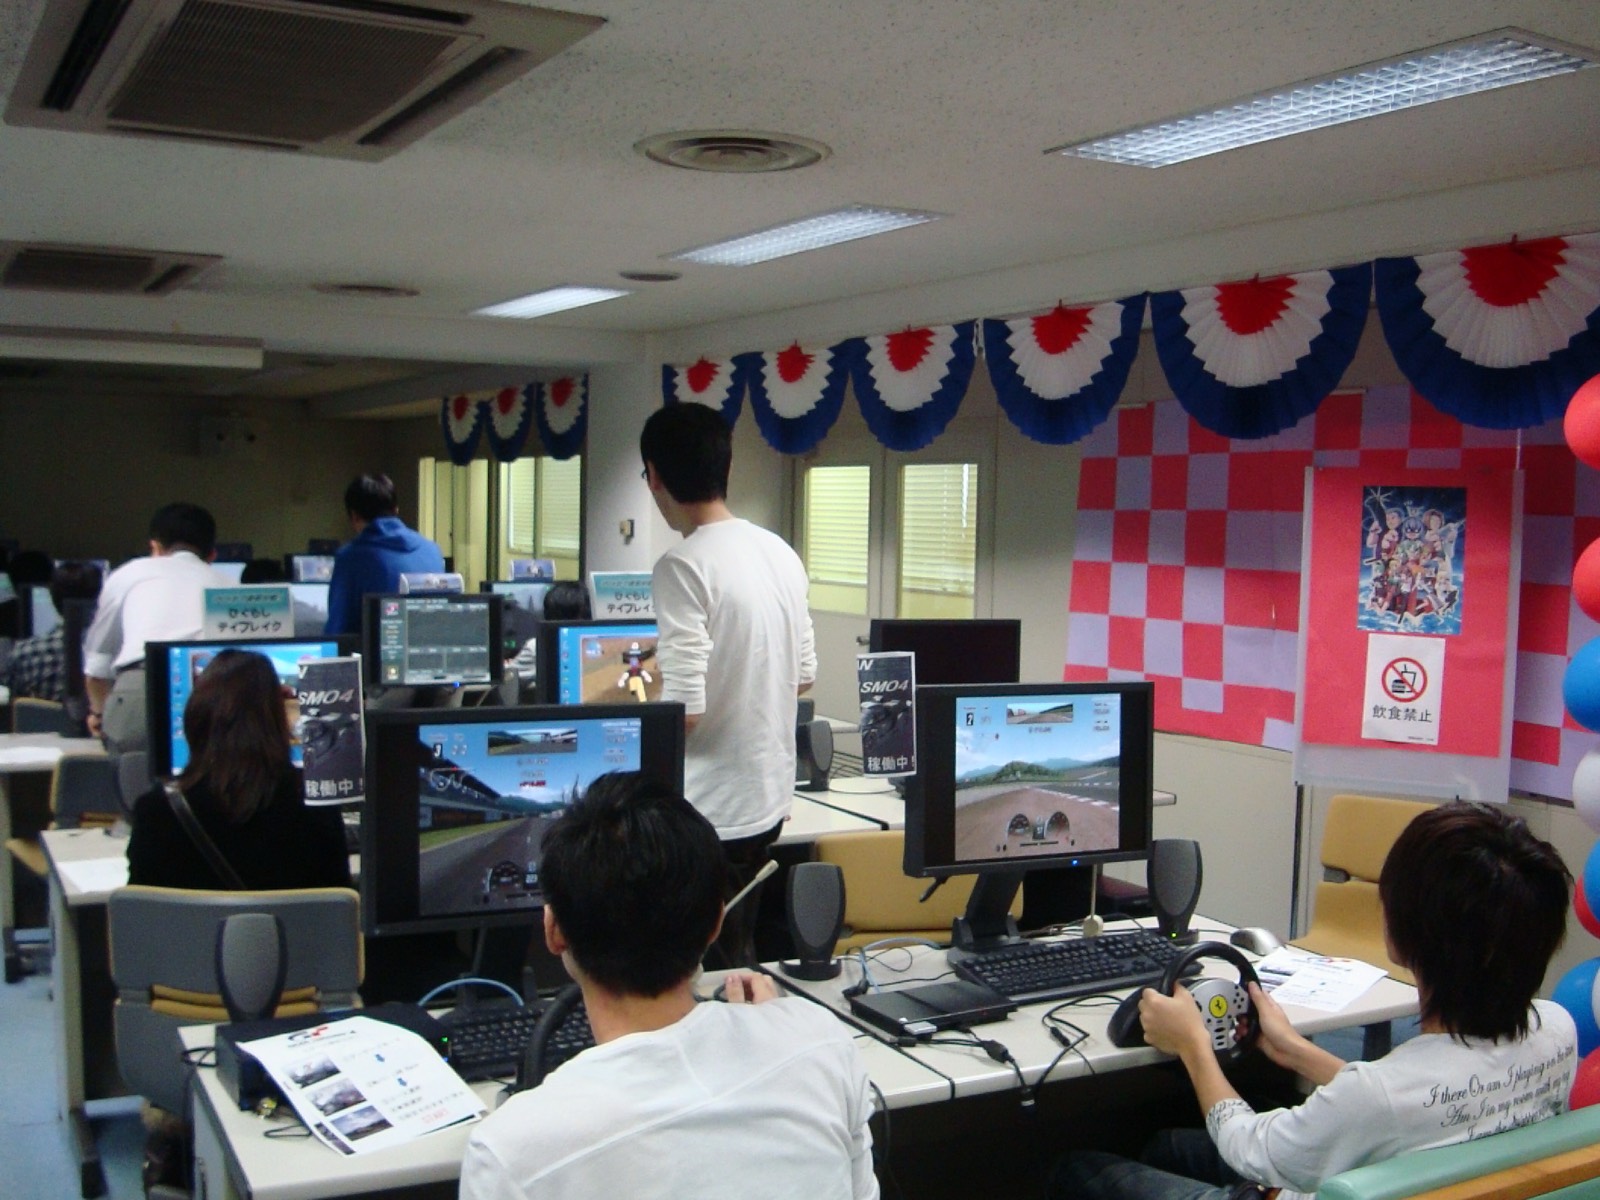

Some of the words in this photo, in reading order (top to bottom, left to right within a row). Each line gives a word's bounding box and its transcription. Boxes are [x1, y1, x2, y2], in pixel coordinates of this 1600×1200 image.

[858, 659, 874, 671] N
[1372, 704, 1433, 723] 飲食禁止
[1512, 1063, 1545, 1092] playing
